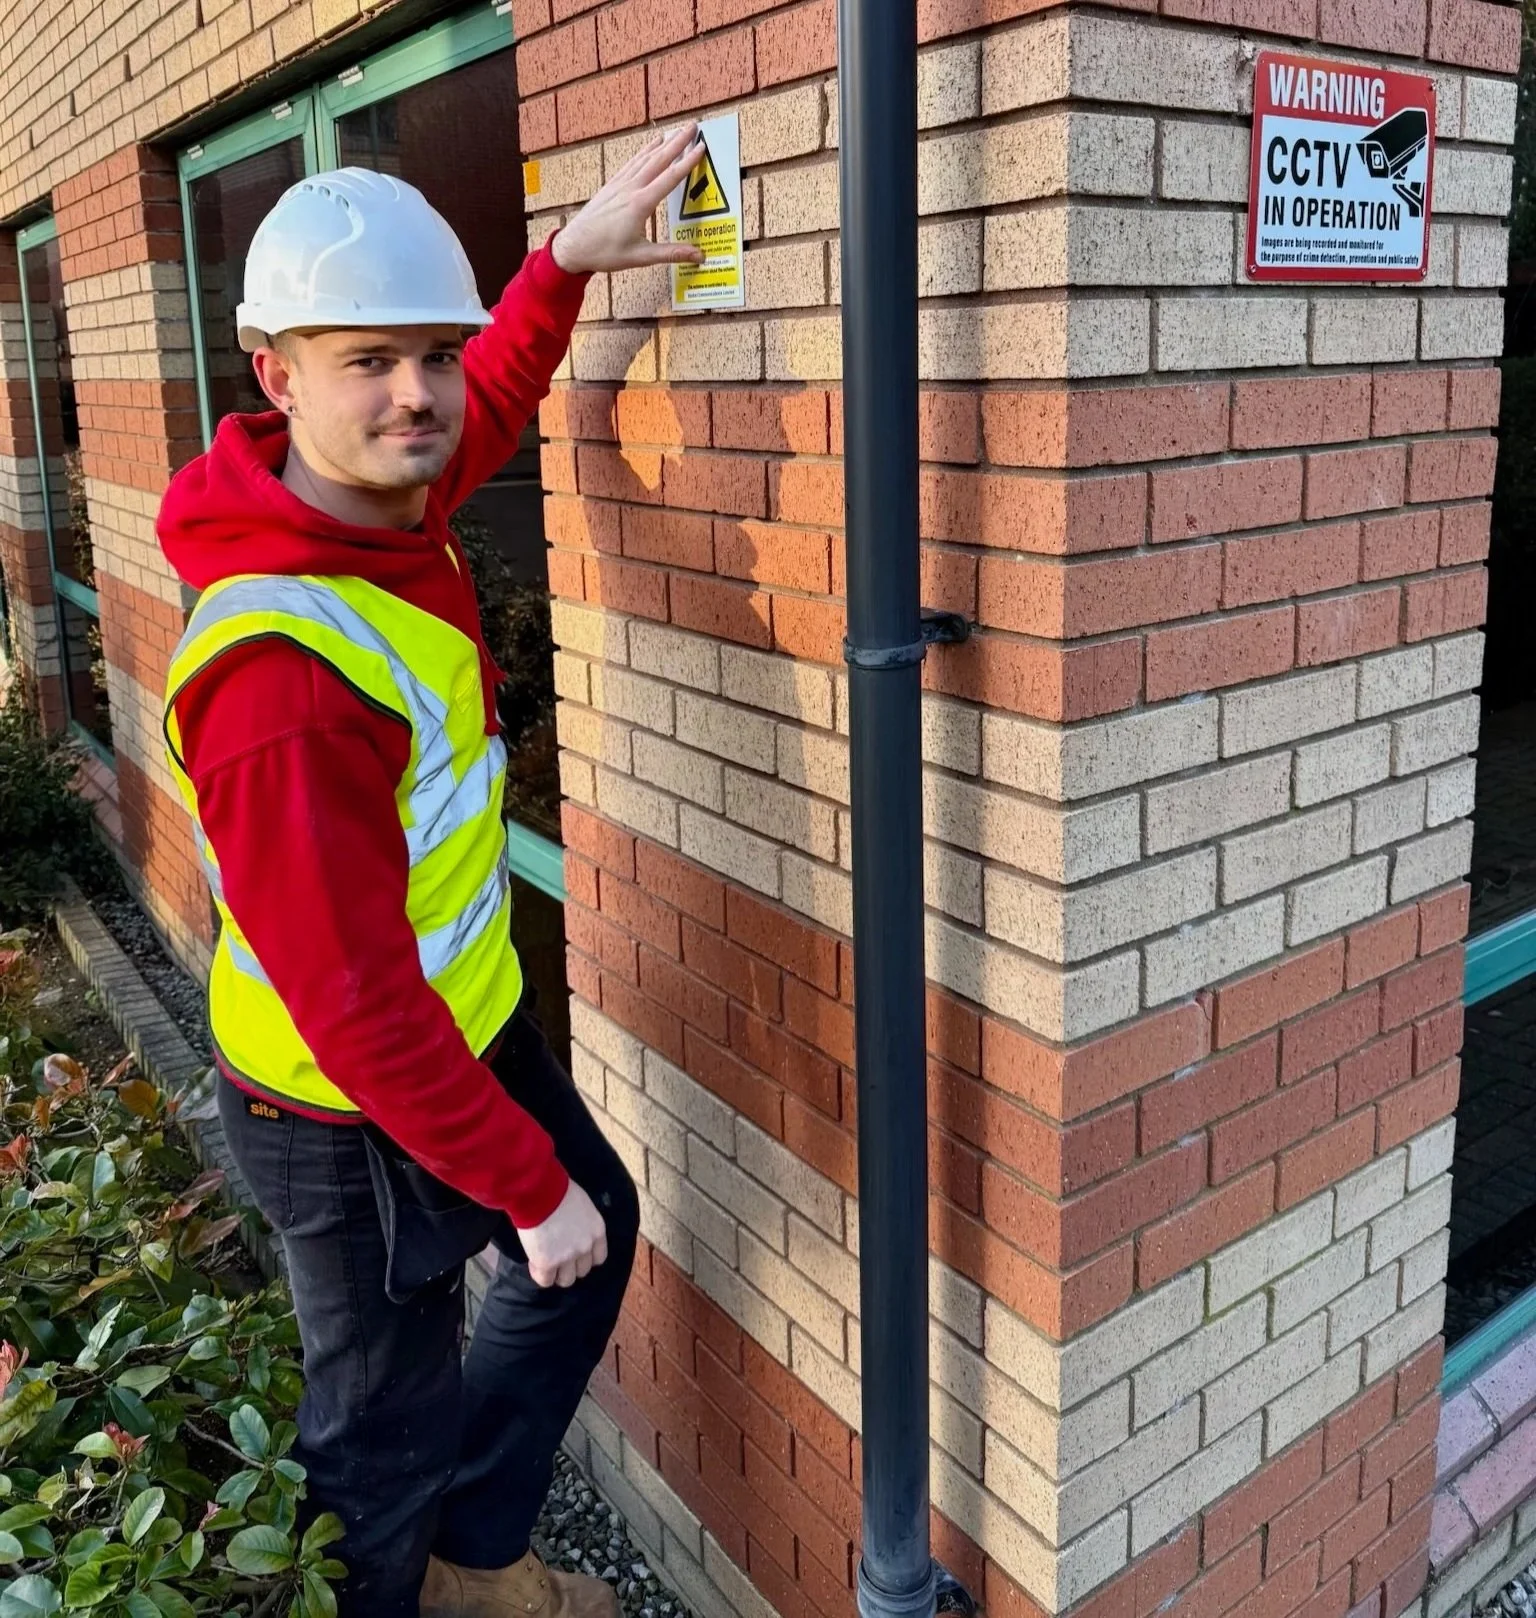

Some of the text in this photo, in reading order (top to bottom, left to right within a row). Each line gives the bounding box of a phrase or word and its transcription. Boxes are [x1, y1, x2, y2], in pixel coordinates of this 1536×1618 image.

[1269, 63, 1386, 119] WARNING
[1267, 136, 1351, 188] CCTV
[1264, 195, 1401, 231] IN OPERATION
[676, 222, 736, 240] CCTV in operation
[1261, 236, 1384, 250] Images are being recorded and monitored for
[1261, 251, 1419, 266] the purpose of crime detection, prevention and public safety
[250, 1102, 279, 1119] site
